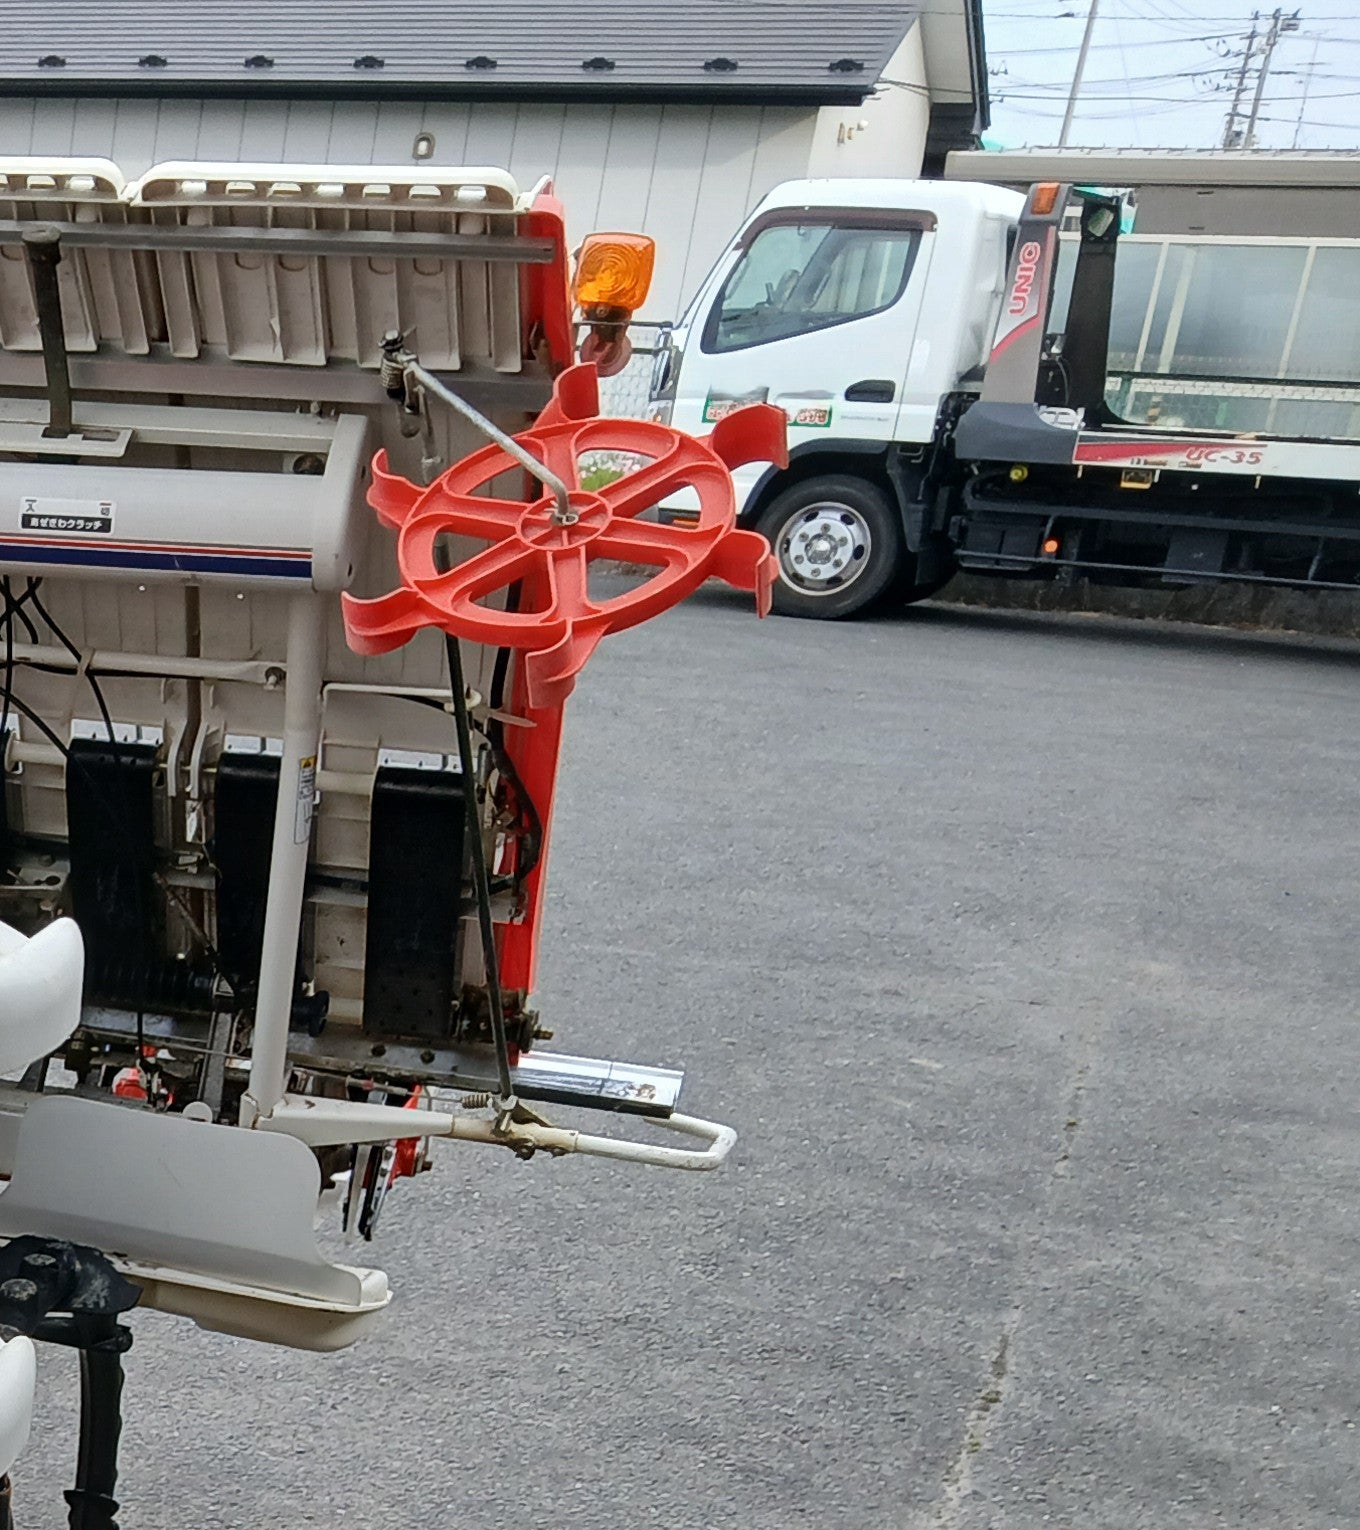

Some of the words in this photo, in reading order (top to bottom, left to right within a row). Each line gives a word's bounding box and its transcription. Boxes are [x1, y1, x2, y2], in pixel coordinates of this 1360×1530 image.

[1008, 241, 1040, 315] UNIC
[1185, 447, 1264, 465] UC-35
[29, 517, 103, 531] あぜぎわクラッチ
